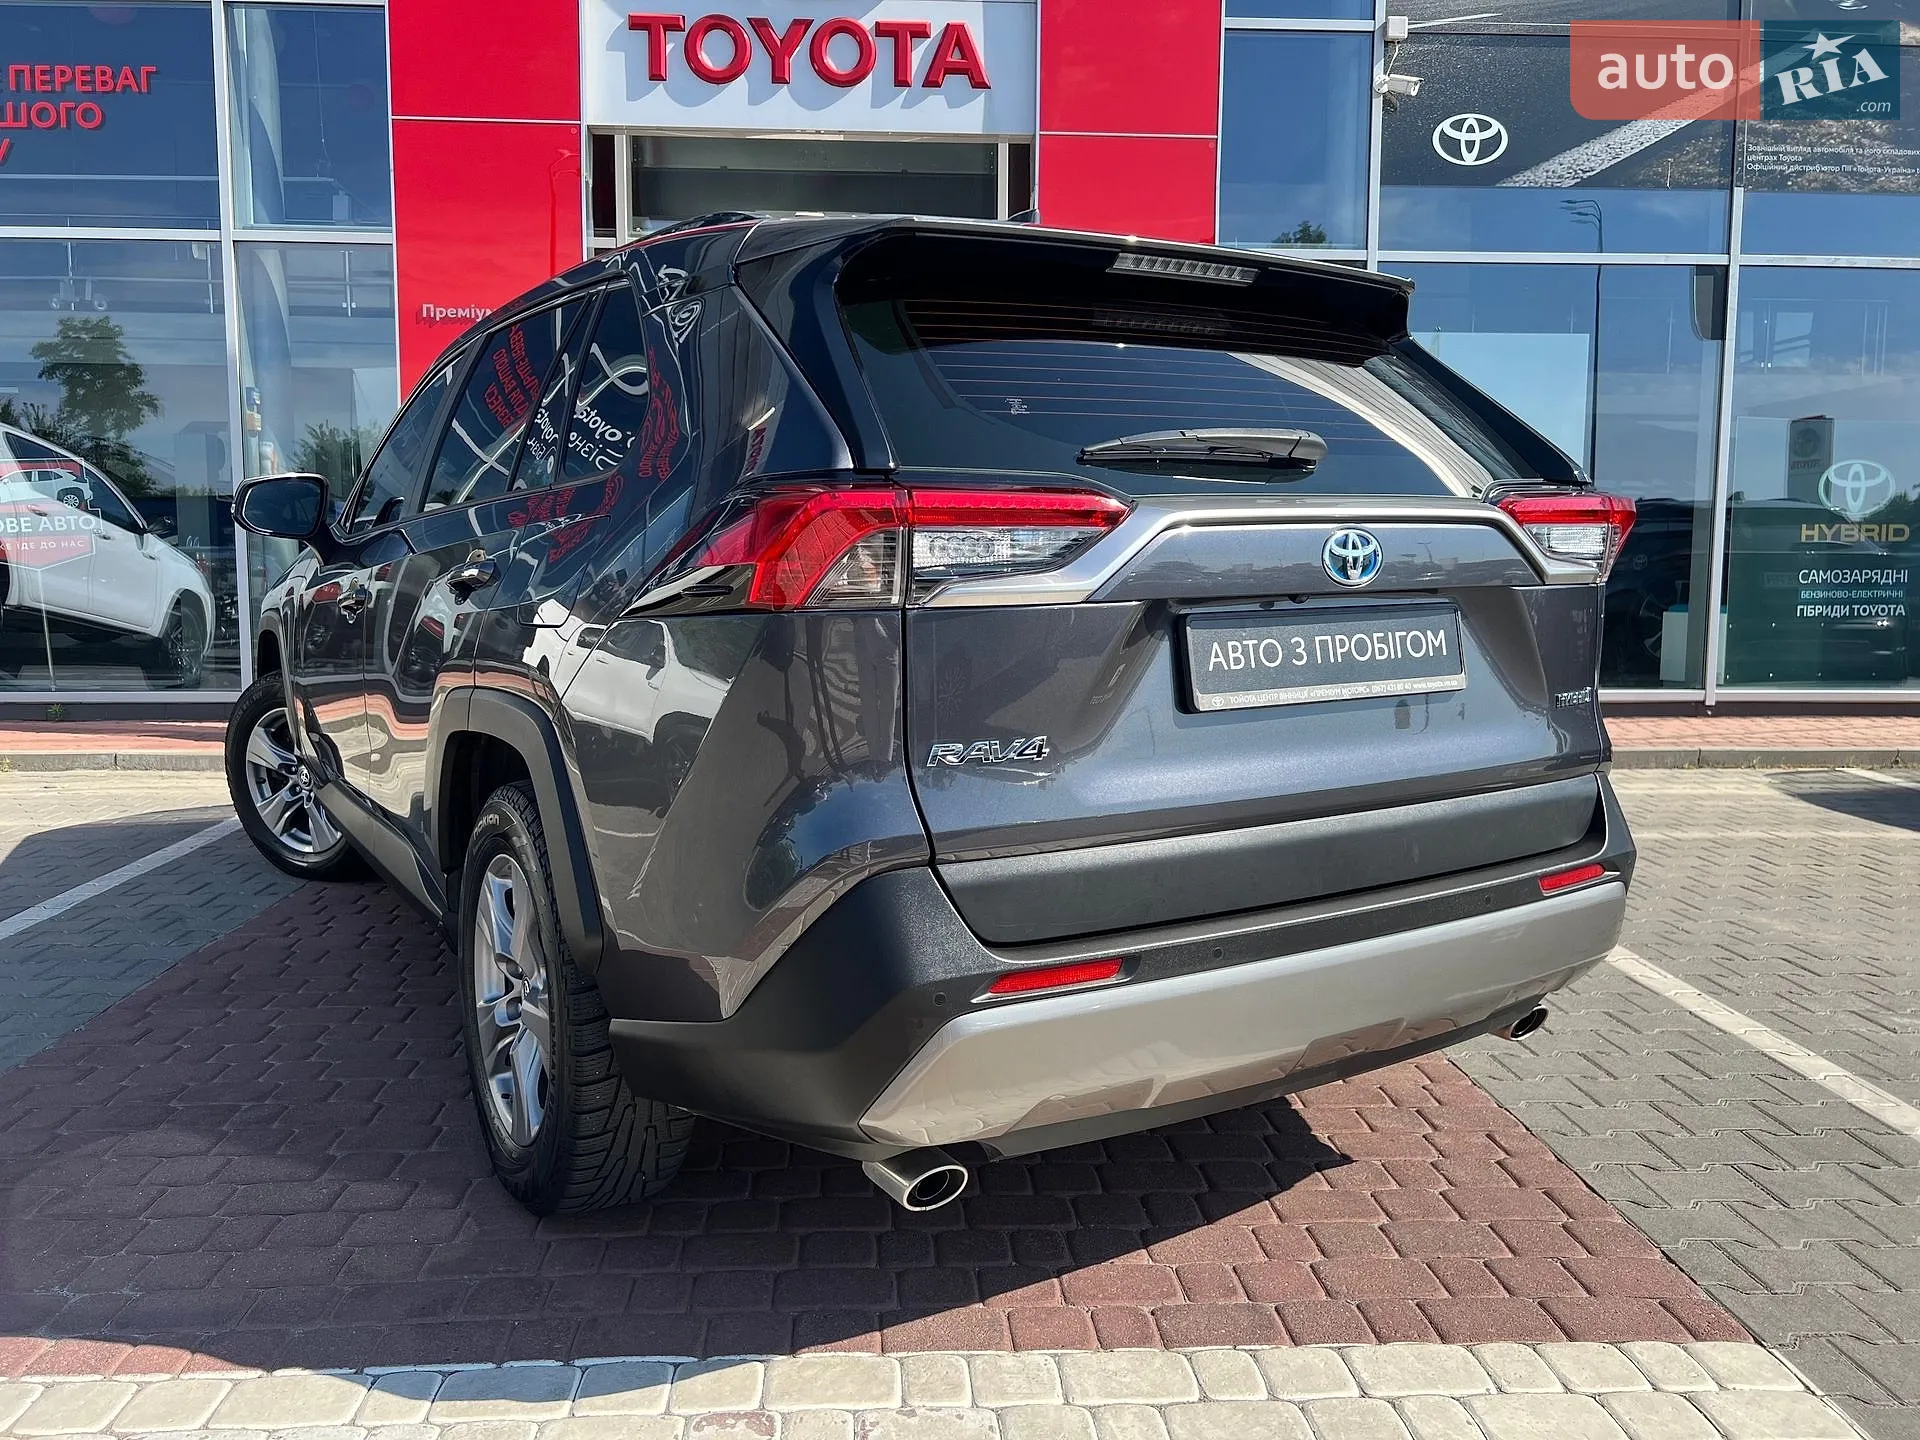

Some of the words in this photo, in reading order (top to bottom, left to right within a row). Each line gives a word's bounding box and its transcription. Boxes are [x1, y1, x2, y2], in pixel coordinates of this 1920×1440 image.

[628, 13, 992, 90] TOYOTA
[8, 64, 157, 94] ПЕРЕВАГ
[1779, 154, 1803, 163] Toyota
[38, 514, 97, 532] АВТО
[1800, 523, 1911, 543] HYBRID
[40, 541, 57, 550] ДО
[60, 540, 85, 548] НАС
[1798, 568, 1909, 586] САМОЗАРЯДНІ
[1800, 589, 1904, 599] БЕНЗИНОВО-ЕЛЕКТРИЧНІ
[1796, 604, 1850, 618] ГІБРИДИ
[1851, 603, 1906, 617] TOYOTA
[1208, 637, 1283, 672] АВТО
[1314, 628, 1447, 664] ПРОБІГОМ
[1257, 692, 1279, 703] ЦЕНТР
[926, 735, 1050, 767] RAV4
